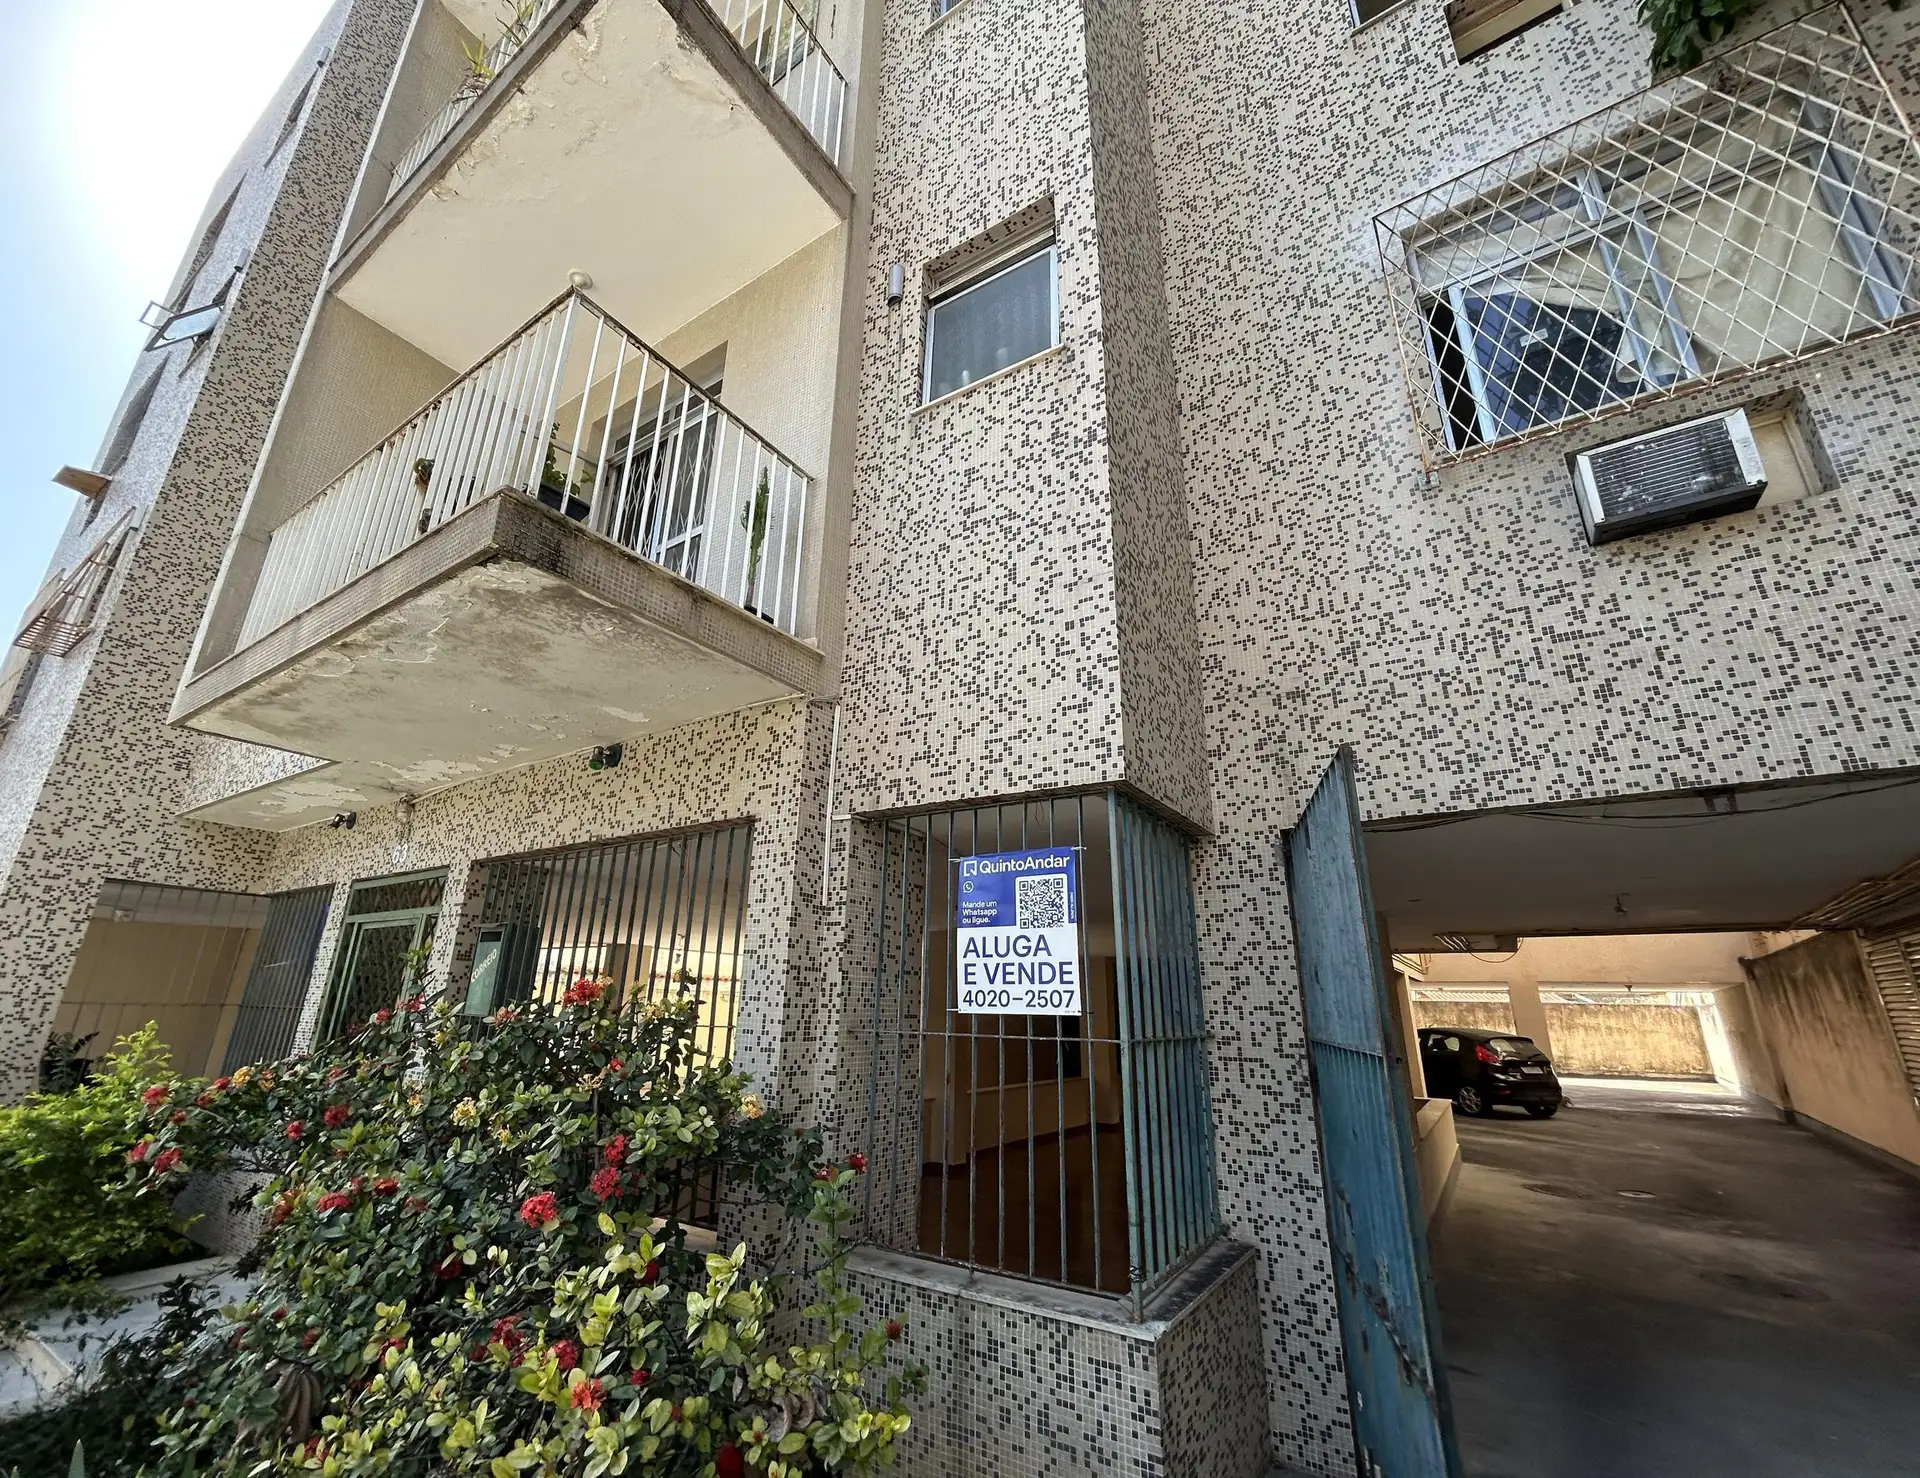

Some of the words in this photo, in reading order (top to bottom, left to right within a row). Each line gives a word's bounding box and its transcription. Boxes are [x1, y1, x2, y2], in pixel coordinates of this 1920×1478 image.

[392, 844, 408, 864] 63
[980, 855, 1069, 874] QuintoAndar
[972, 917, 991, 925] ligue.
[963, 934, 1052, 958] ALUGA
[471, 949, 497, 983] CORREIO
[964, 963, 977, 985] E
[983, 961, 1074, 985] VENDE
[963, 990, 1075, 1008] 4020-2507
